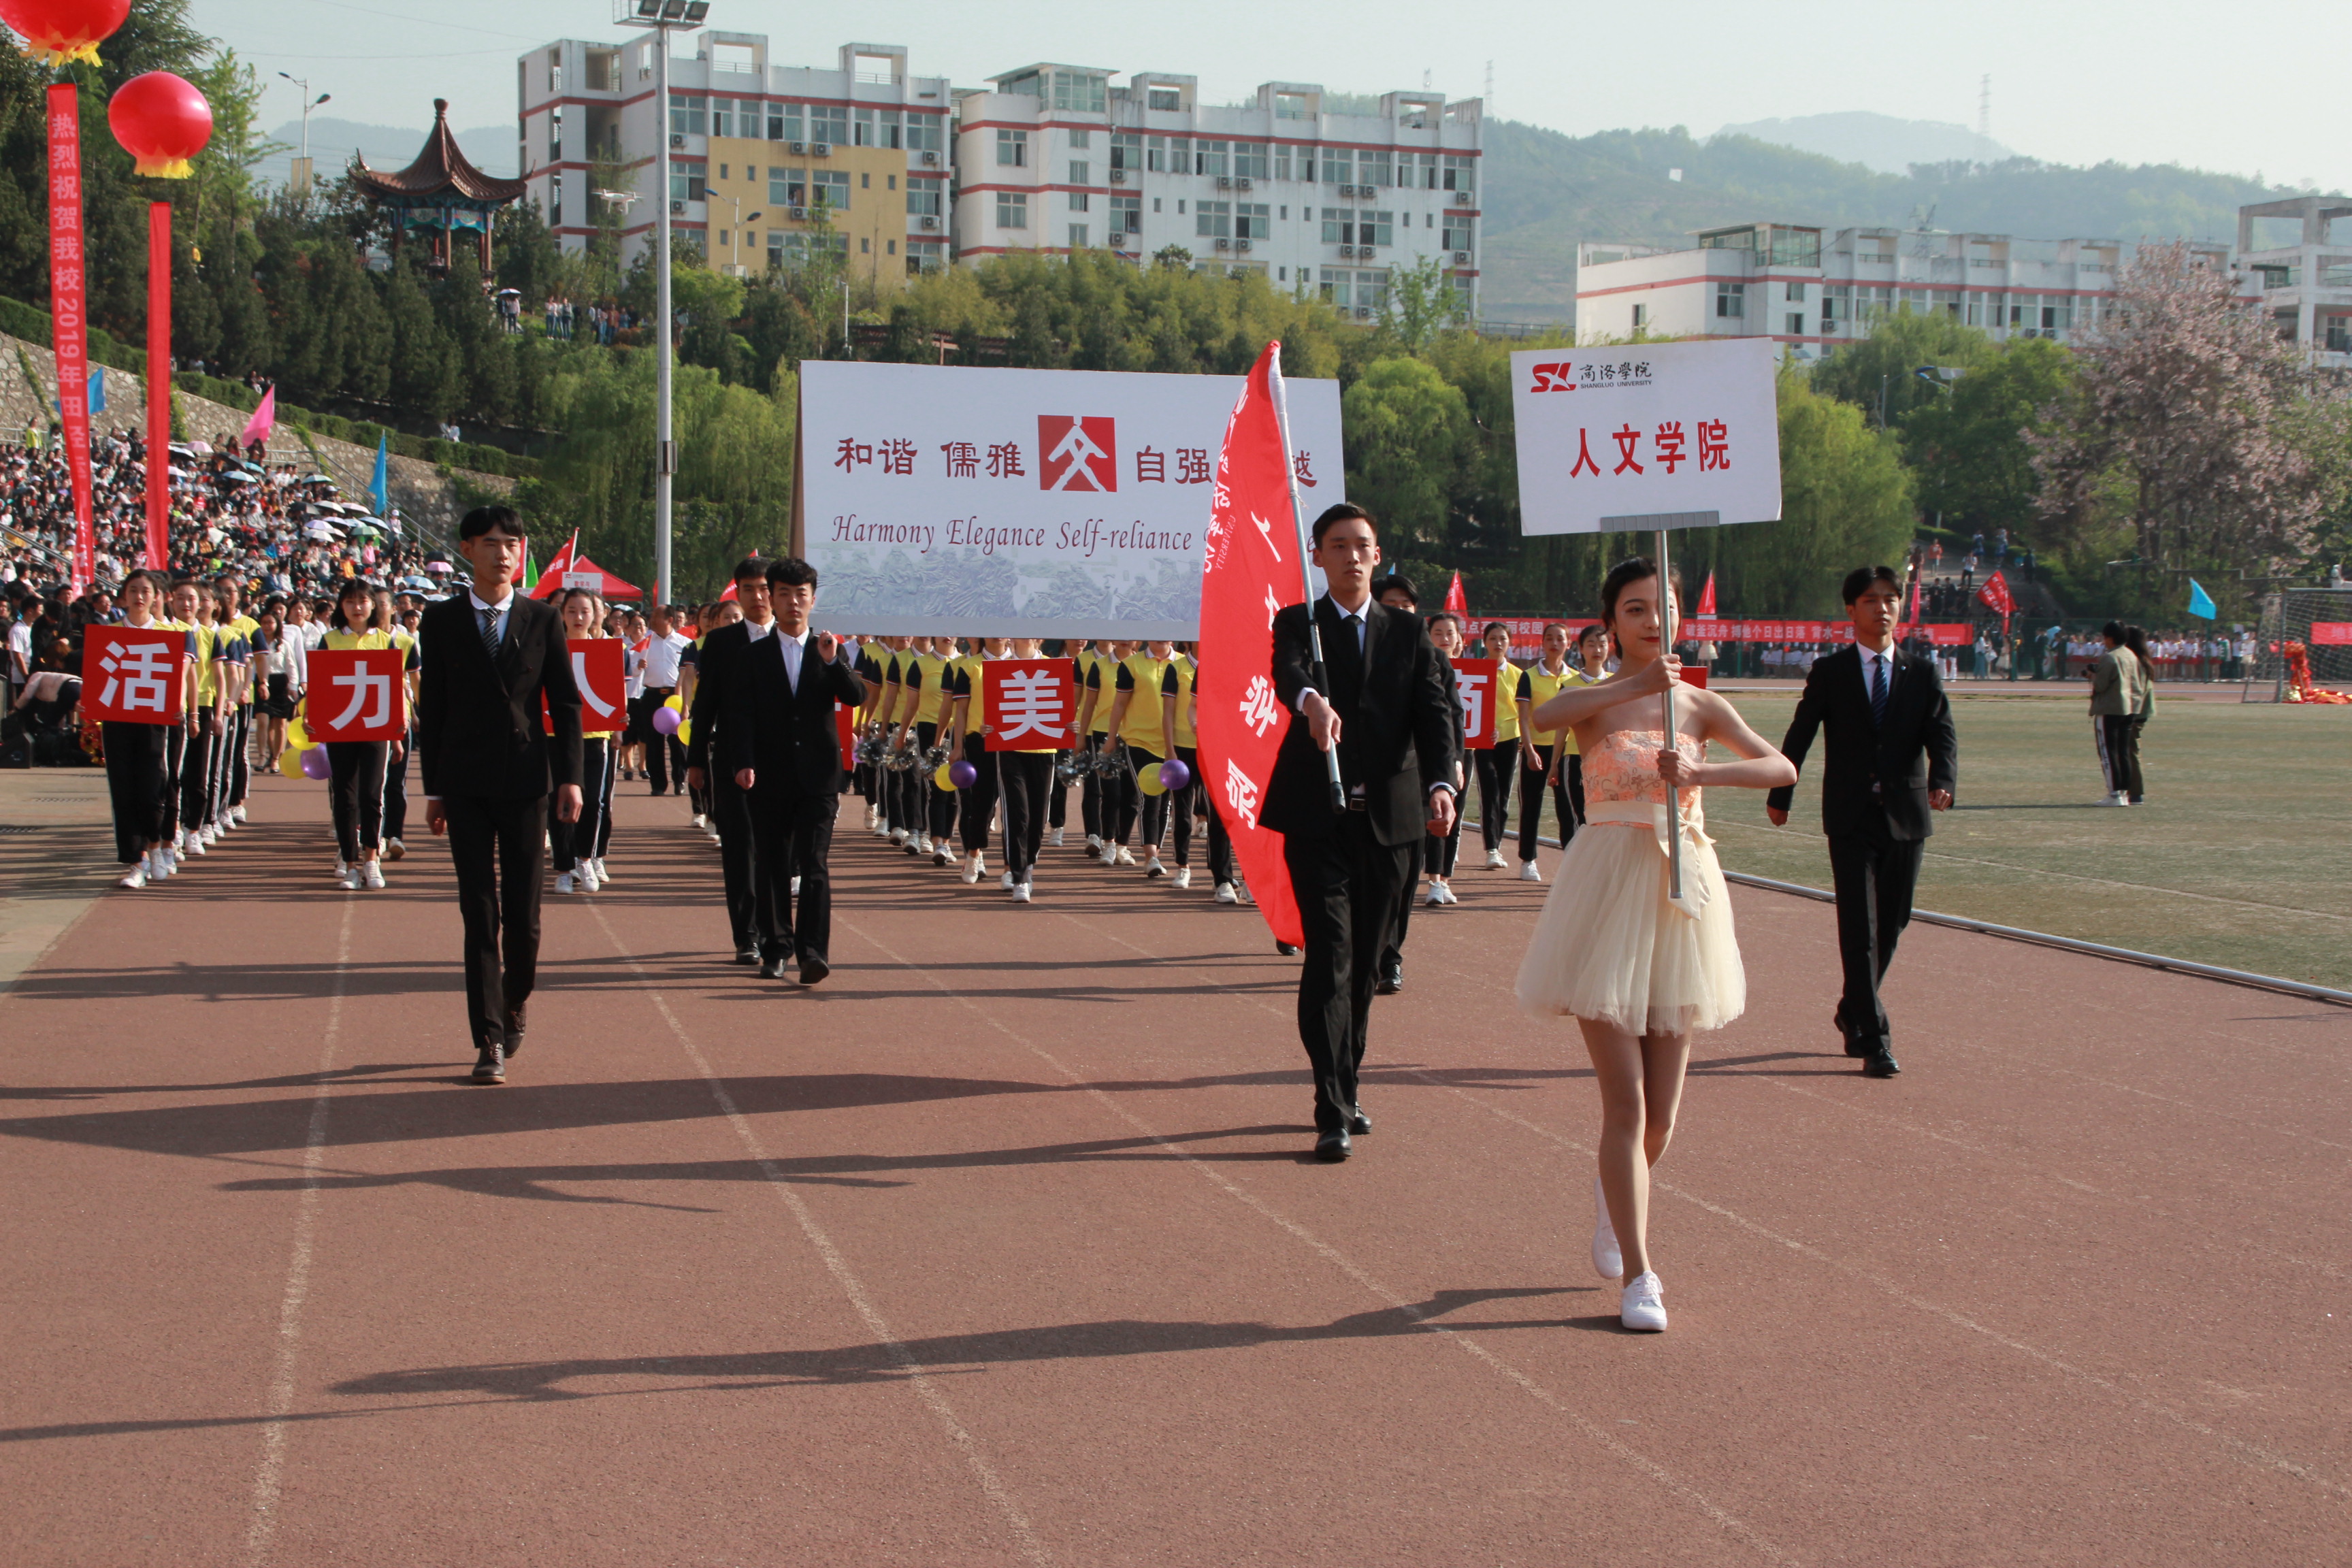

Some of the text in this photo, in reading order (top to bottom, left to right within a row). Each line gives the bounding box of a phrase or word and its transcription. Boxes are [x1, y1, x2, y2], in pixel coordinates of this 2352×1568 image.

[834, 437, 918, 475] 和谐
[941, 441, 1026, 480] 儒雅
[1137, 446, 1213, 485] 自强
[1569, 419, 1731, 478] 人文学院
[832, 514, 934, 554] Harmony
[948, 516, 1045, 555] Elegance
[1057, 519, 1192, 557] Self-reliance
[100, 642, 172, 713] 活
[329, 661, 391, 730] 力
[998, 669, 1065, 740] 美
